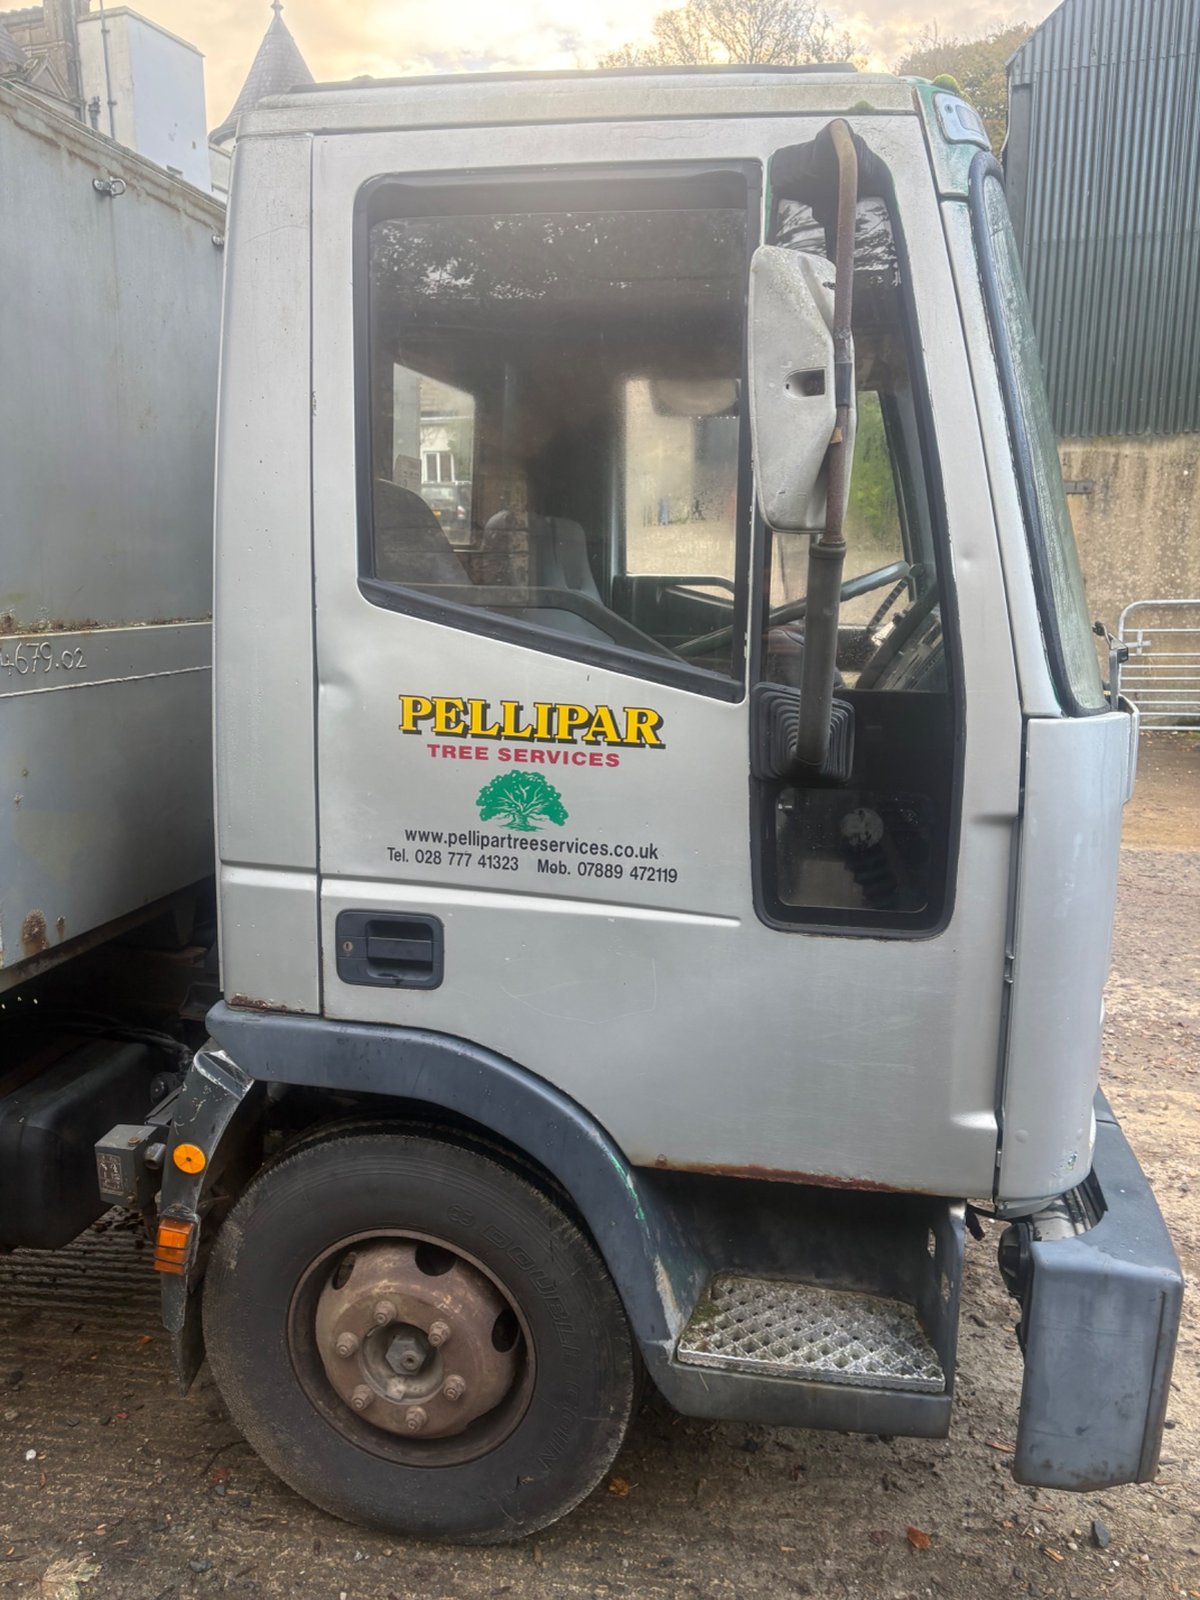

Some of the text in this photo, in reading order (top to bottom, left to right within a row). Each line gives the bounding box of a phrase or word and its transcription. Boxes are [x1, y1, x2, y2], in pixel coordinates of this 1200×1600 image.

[398, 694, 667, 750] PELLIPAR
[427, 744, 620, 768] TREE SERVICES
[404, 828, 660, 861] www.pellipartreeservices.co.uk
[386, 846, 678, 884] Tel. 028 777 41323 Mob. 07889 472119
